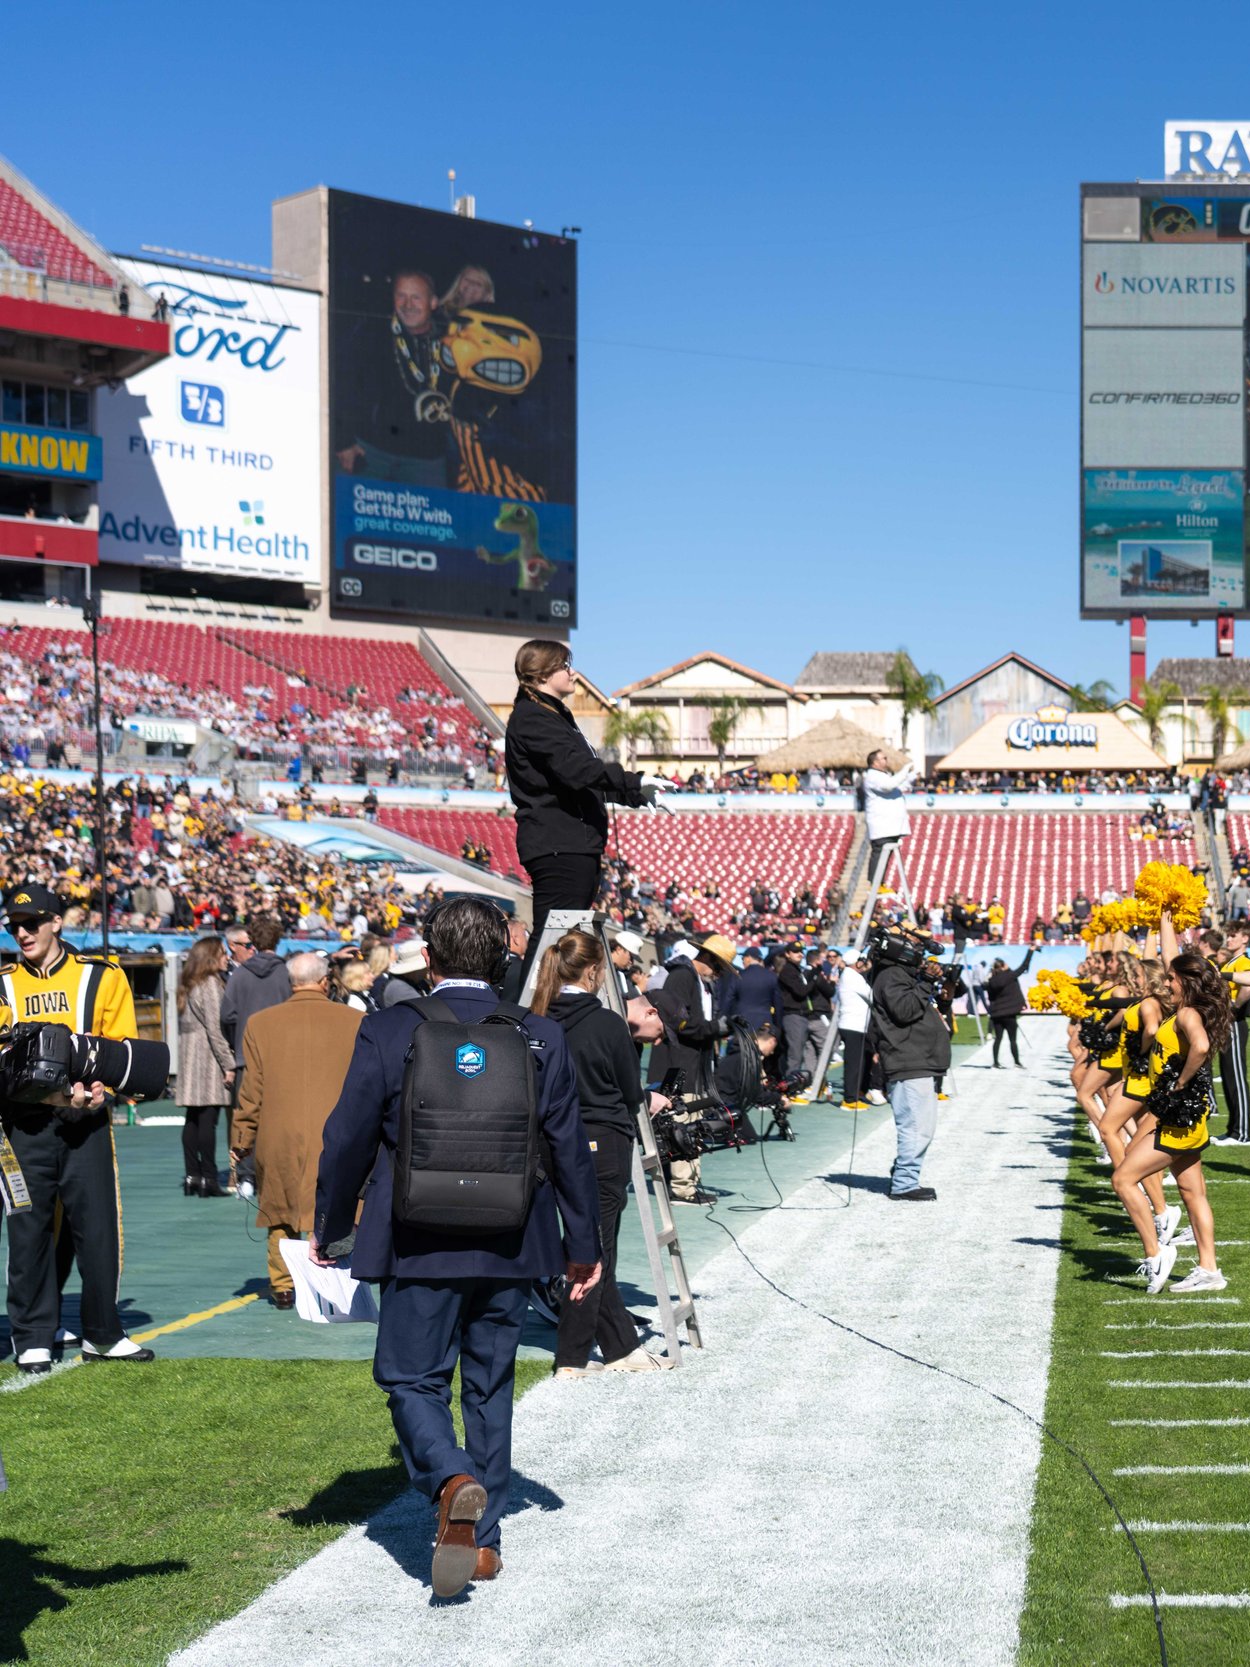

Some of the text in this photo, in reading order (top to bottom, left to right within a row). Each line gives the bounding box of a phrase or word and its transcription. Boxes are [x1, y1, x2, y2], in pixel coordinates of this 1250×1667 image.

[1121, 276, 1236, 295] NOVARTIS
[1089, 391, 1241, 405] CONFIRMED360
[1, 430, 89, 474] KNOW
[129, 435, 274, 471] FIFTH THIRD
[354, 483, 430, 508] Game plan:
[354, 500, 453, 525] Get the W with
[1176, 513, 1219, 528] Hilton
[354, 516, 458, 543] great coverage.
[353, 543, 438, 572] GEICO
[1008, 717, 1098, 750] Corona
[25, 991, 69, 1016] IOWA
